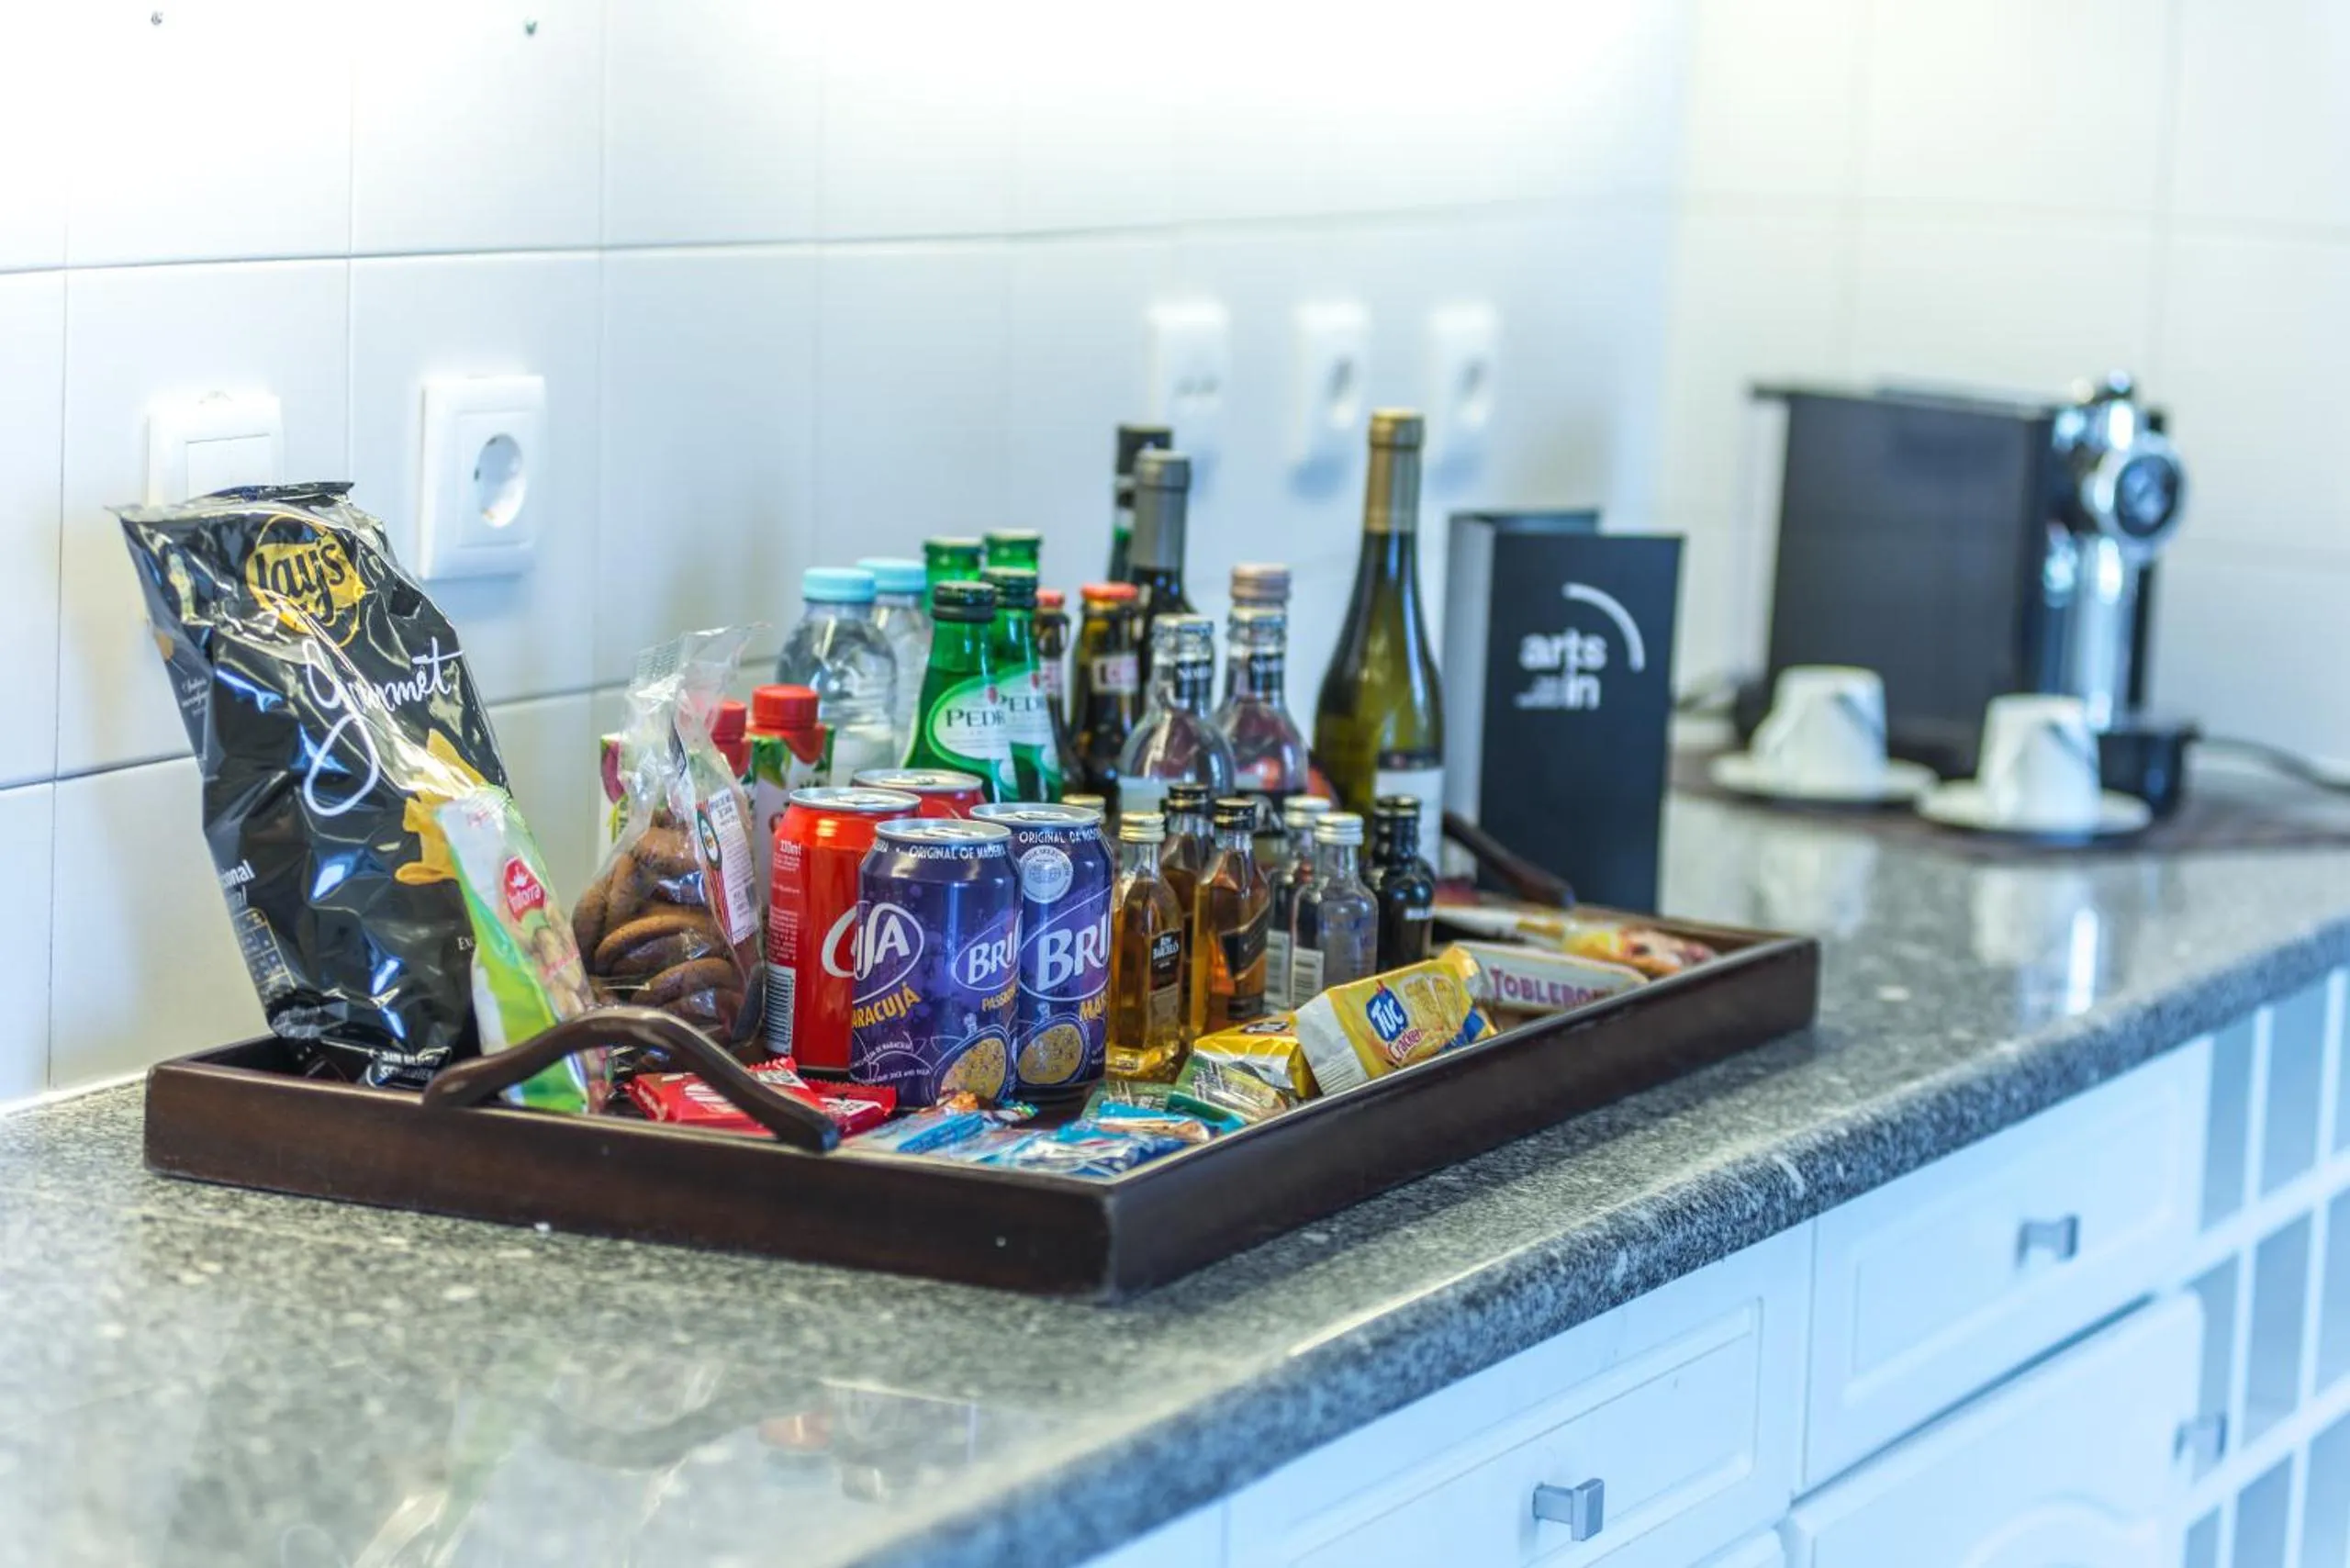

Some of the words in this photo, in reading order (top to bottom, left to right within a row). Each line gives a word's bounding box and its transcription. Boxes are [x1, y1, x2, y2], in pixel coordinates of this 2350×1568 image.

[946, 707, 1006, 728] PEDR
[909, 845, 957, 859] ORIGINAL
[1019, 830, 1066, 844] ORIGINAL
[968, 931, 1014, 985] BRI
[1036, 911, 1107, 992] BRI
[852, 980, 922, 1028] ARACUJÁ
[1371, 998, 1405, 1038] TUC
